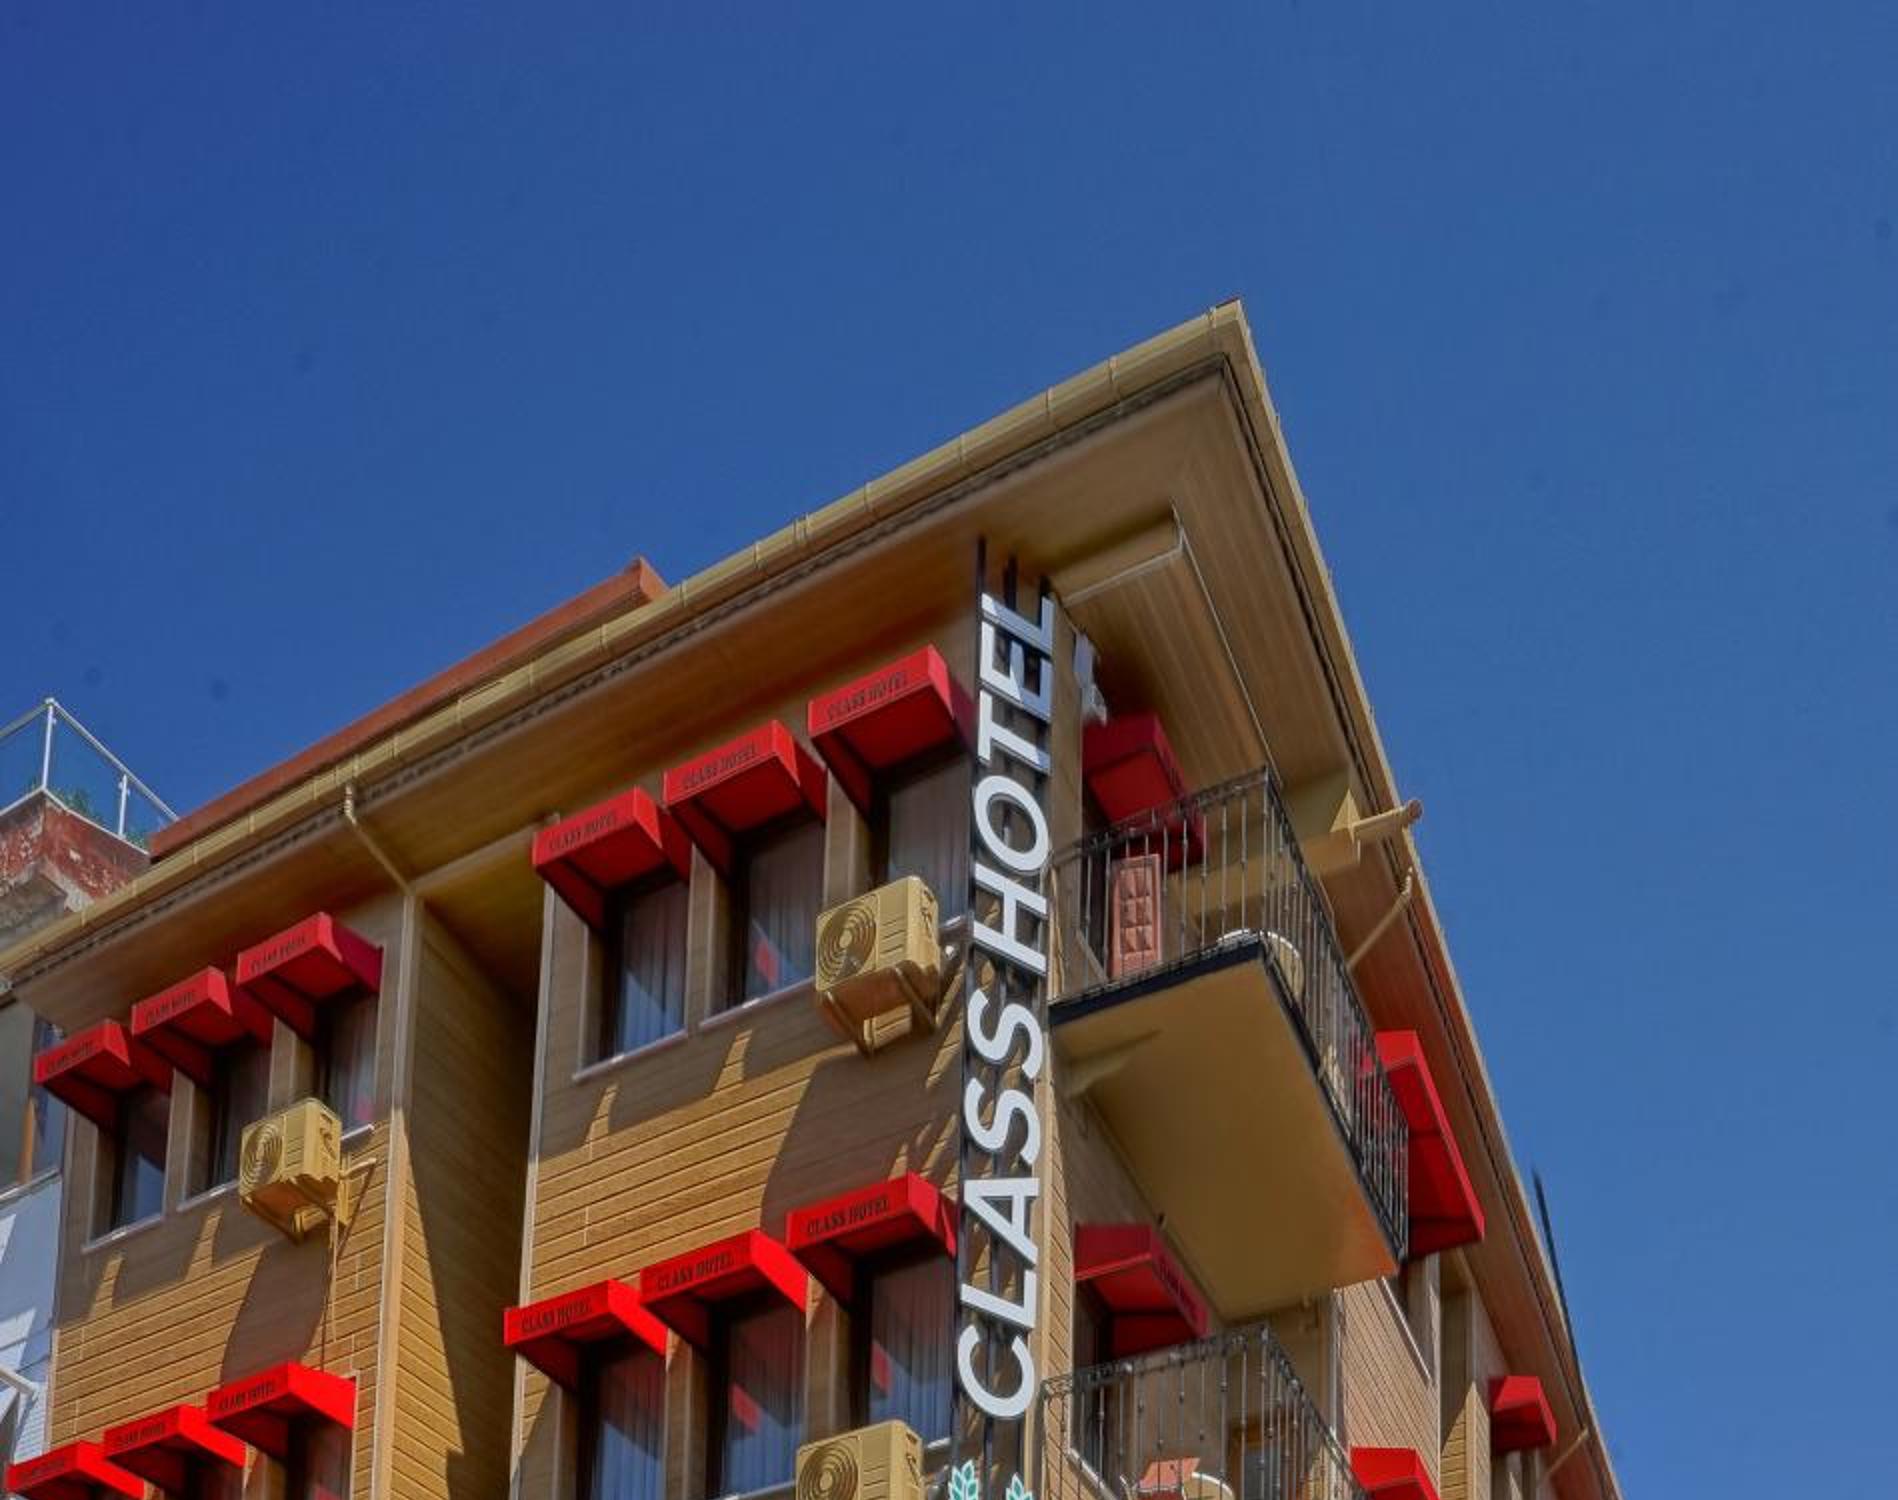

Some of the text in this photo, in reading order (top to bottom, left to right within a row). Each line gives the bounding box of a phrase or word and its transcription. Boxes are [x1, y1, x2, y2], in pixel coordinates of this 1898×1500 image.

[957, 592, 1056, 1420] CLASS HOTEL
[807, 1194, 889, 1237] CLASS HOTEL
[657, 1251, 734, 1291] CLASS HOTEL
[521, 1297, 592, 1333] CLASS HOTEL
